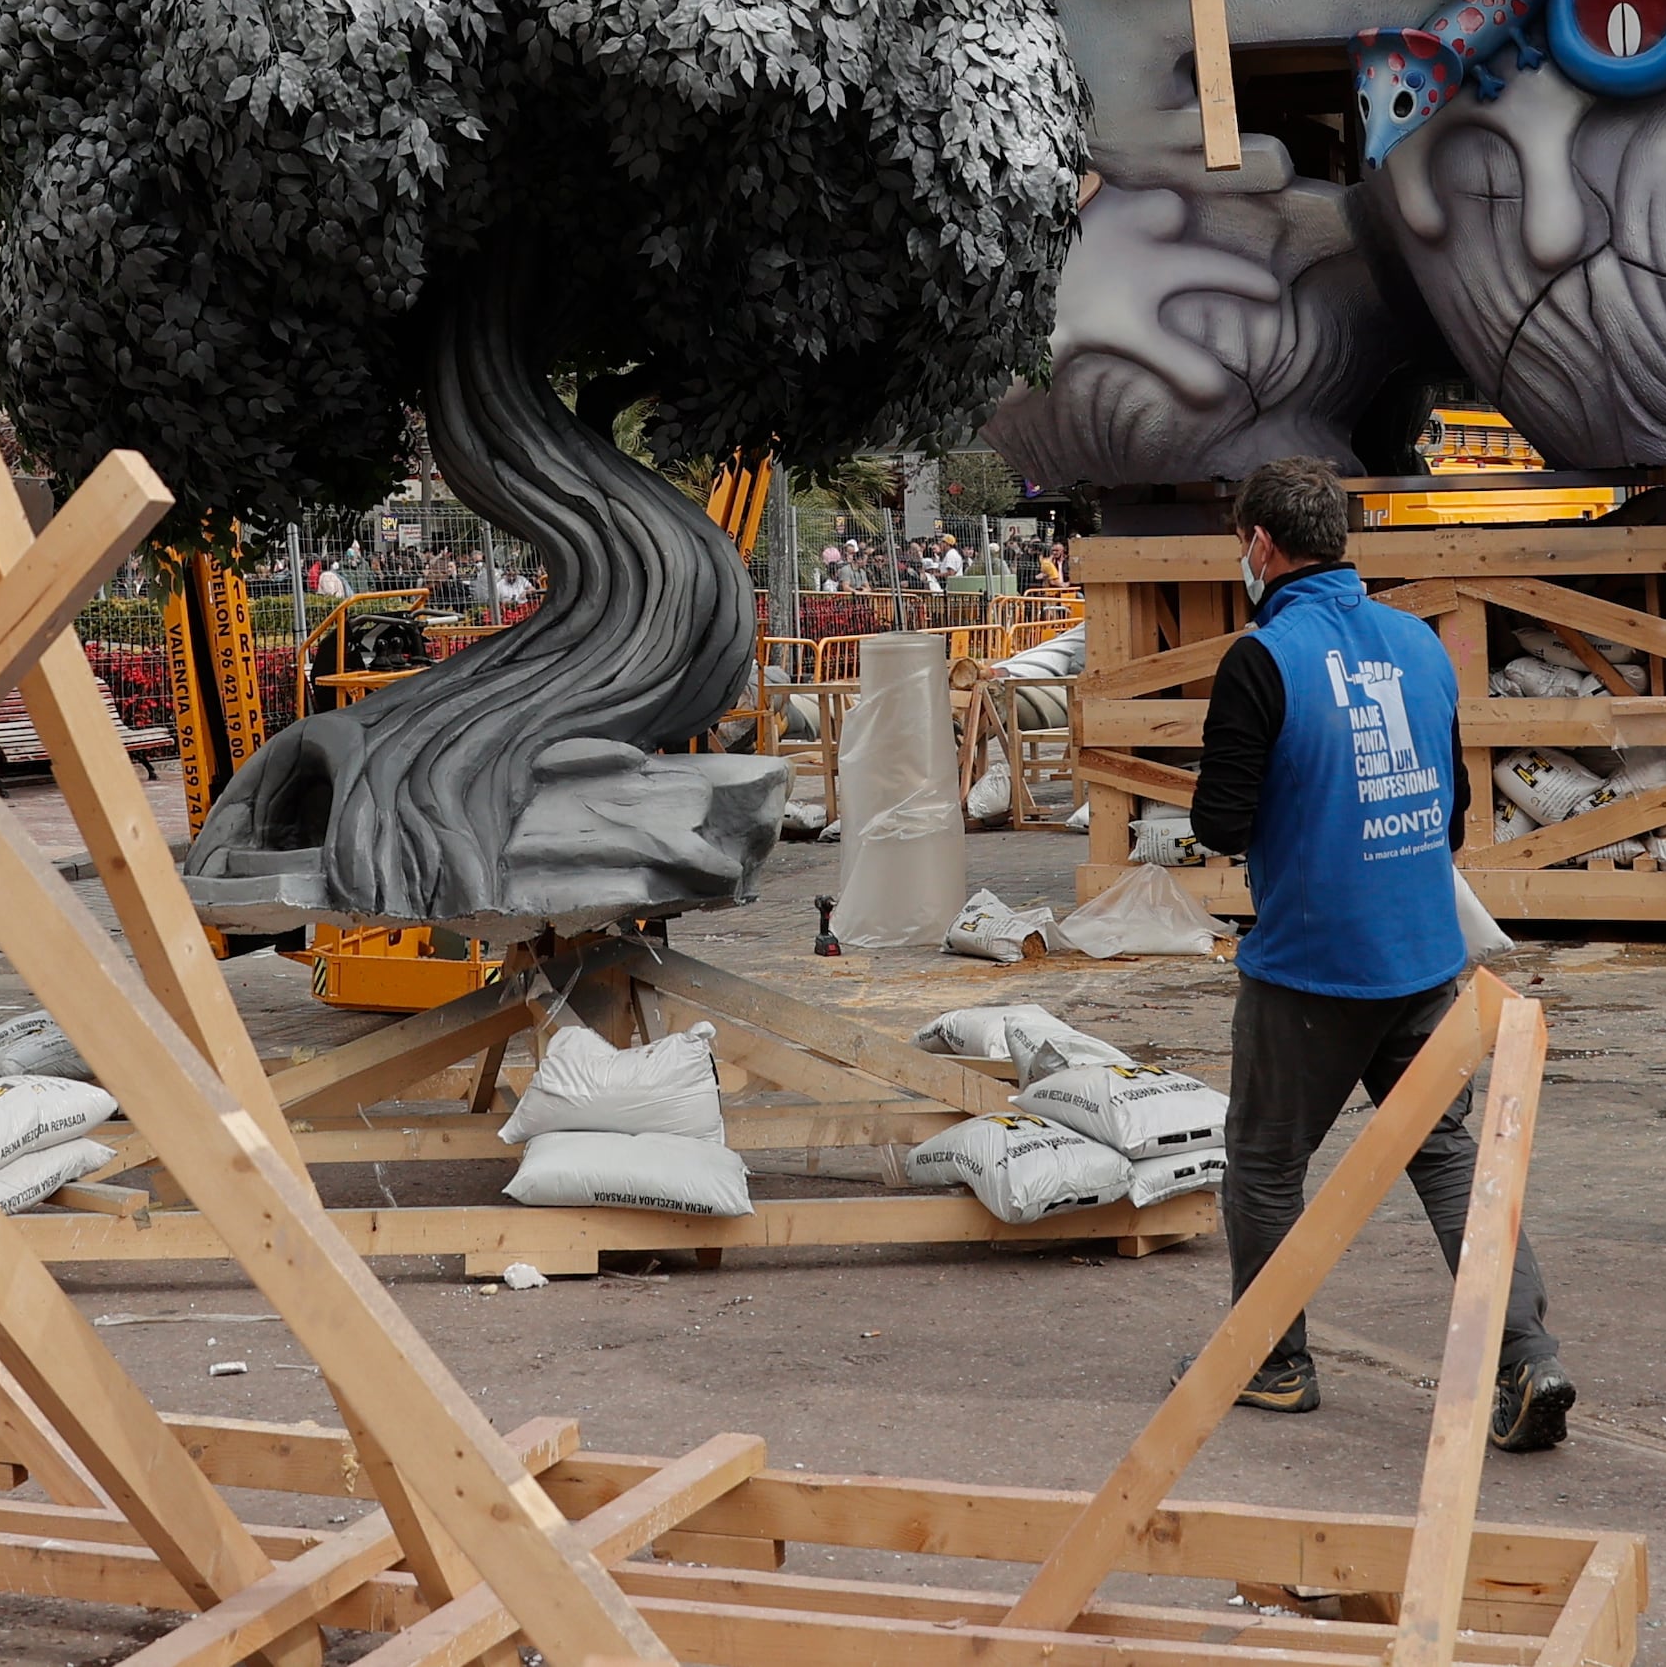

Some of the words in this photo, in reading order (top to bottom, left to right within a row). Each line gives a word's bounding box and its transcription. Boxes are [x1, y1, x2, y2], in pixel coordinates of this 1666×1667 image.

[168, 622, 192, 716] VALENCIA
[221, 648, 235, 669] 96
[223, 675, 238, 704] 421
[228, 711, 241, 732] 19
[180, 725, 194, 748] 96
[231, 736, 244, 760] 00
[1353, 729, 1387, 755] PINTA
[183, 754, 199, 787] 159
[1355, 751, 1390, 778] COMO
[1395, 748, 1413, 771] UN
[1358, 766, 1440, 804] PROFESIONAL
[188, 792, 202, 815] 74
[1363, 798, 1443, 840] MONTÓ
[1363, 851, 1373, 862] La
[1375, 847, 1399, 861] marca
[1399, 843, 1412, 855] del
[50, 1112, 86, 1135] REPASADA
[593, 1191, 637, 1204] REPASADA
[638, 1195, 683, 1210] MEZCLADA
[685, 1202, 714, 1214] ARENA
